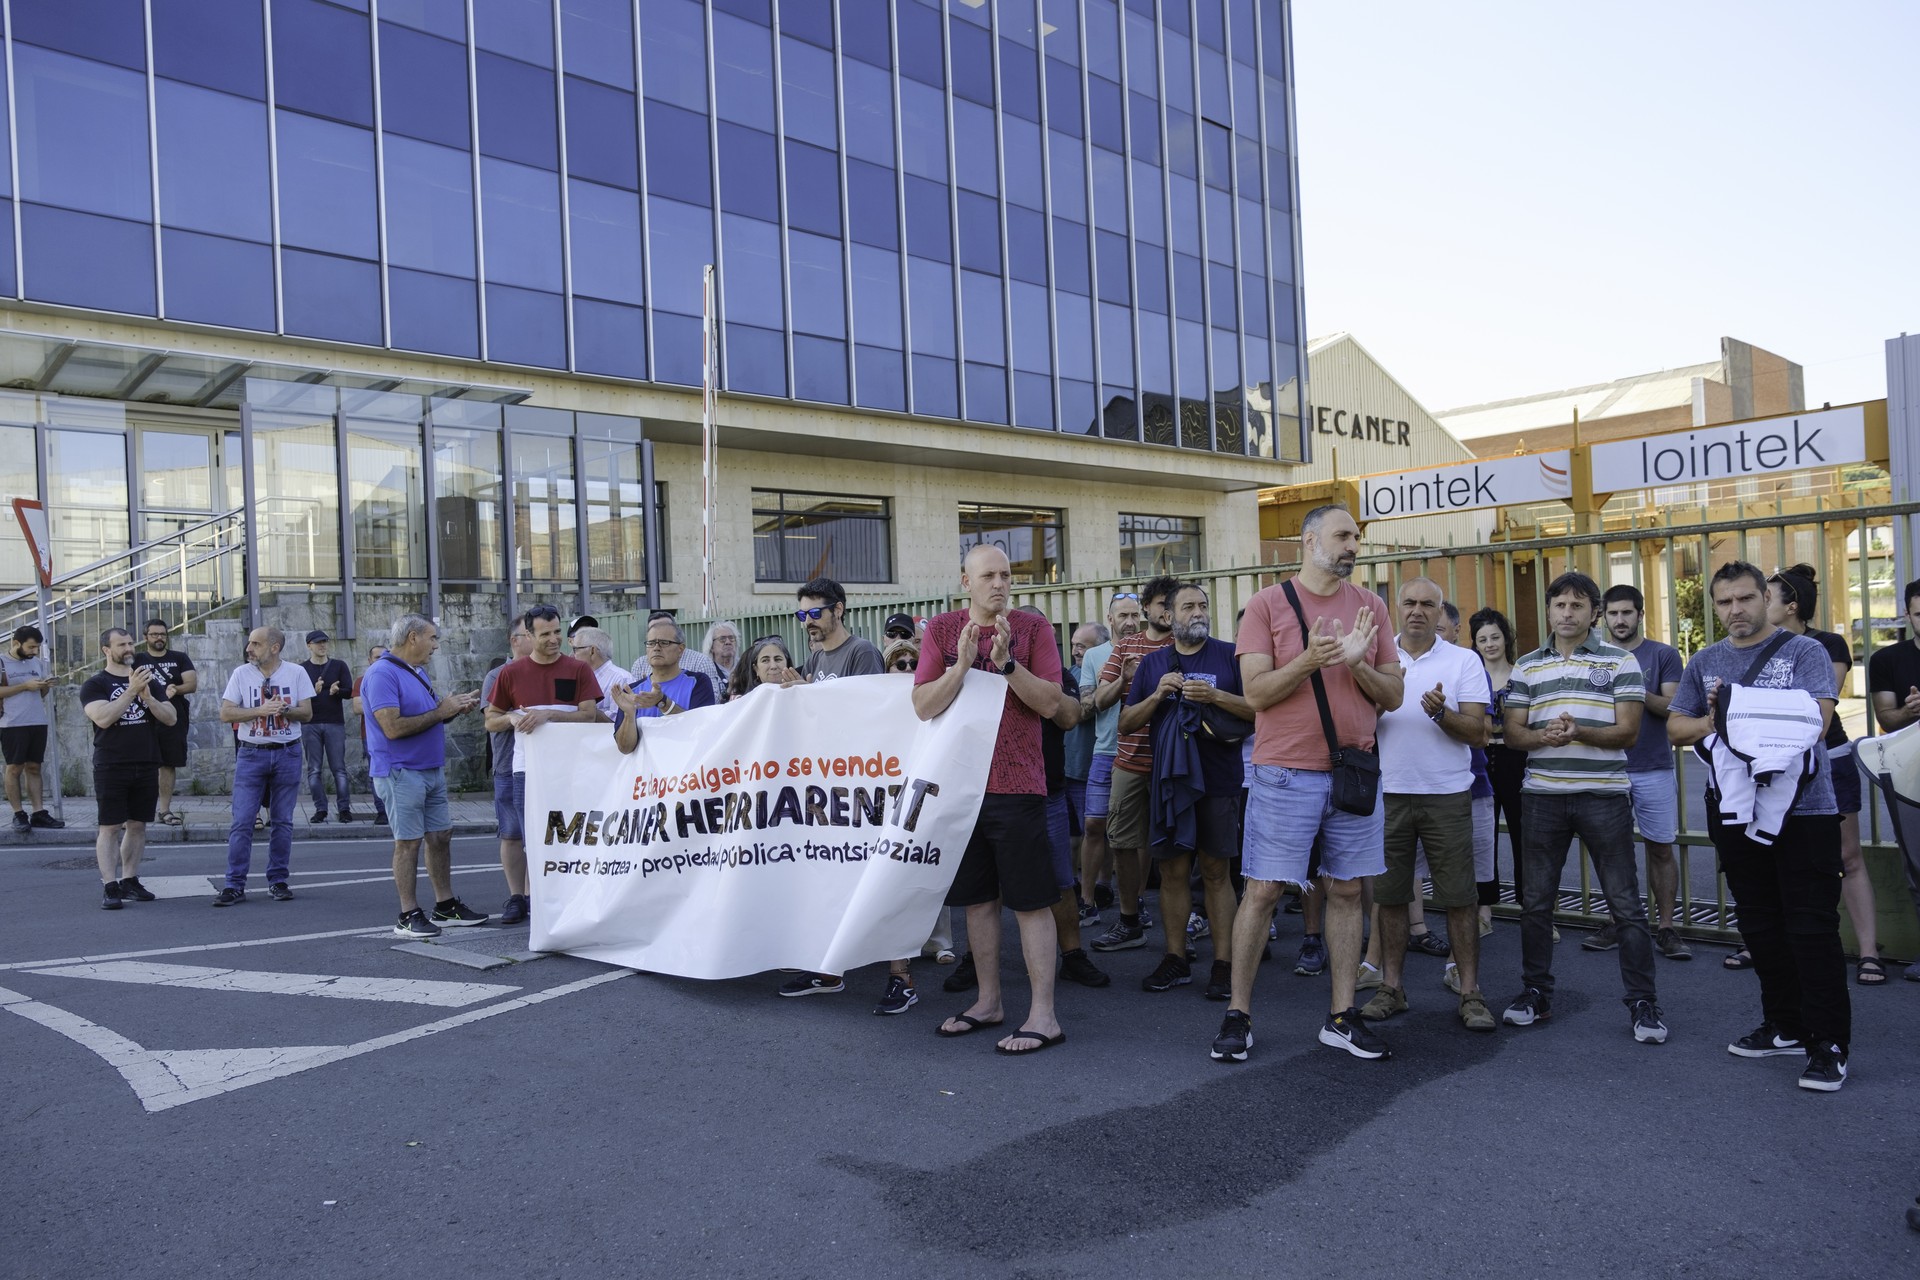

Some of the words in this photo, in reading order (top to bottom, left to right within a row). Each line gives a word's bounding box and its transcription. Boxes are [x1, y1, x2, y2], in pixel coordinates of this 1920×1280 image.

[1642, 419, 1825, 483] lointek
[1365, 466, 1497, 516] lointek
[633, 775, 647, 800] Ez
[786, 757, 812, 777] se
[818, 751, 902, 778] vende
[544, 801, 670, 846] MECANER
[543, 859, 591, 876] parte
[593, 857, 630, 876] hartzea
